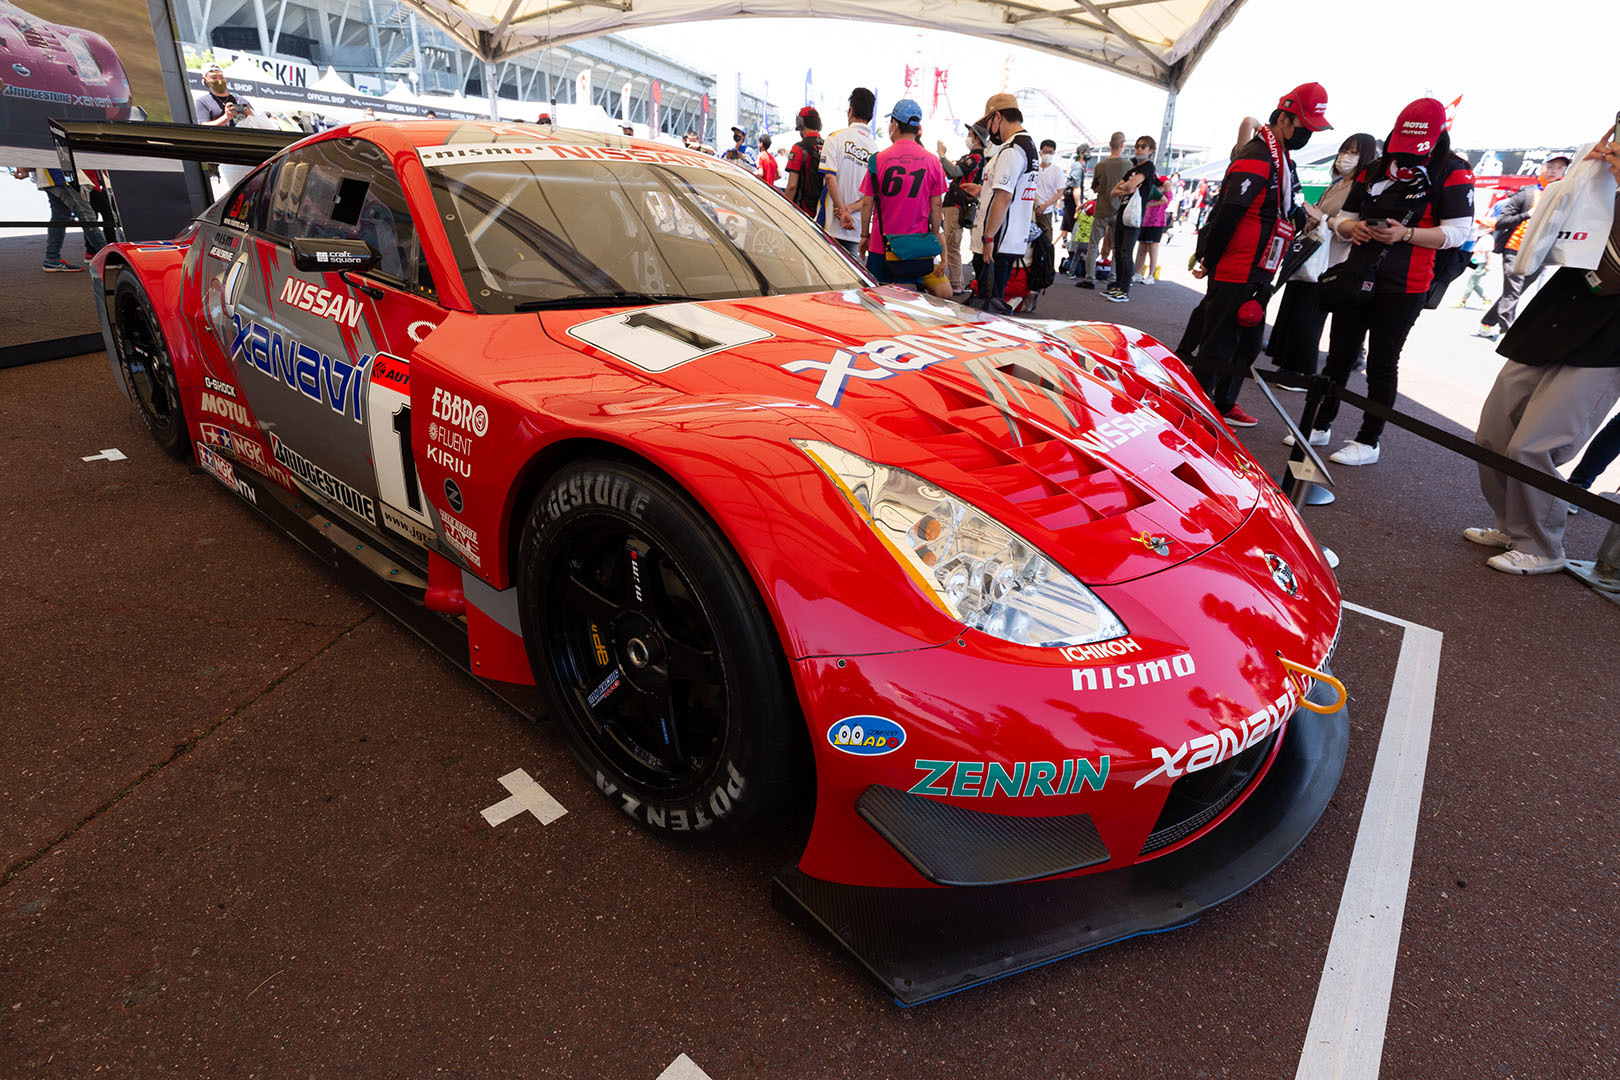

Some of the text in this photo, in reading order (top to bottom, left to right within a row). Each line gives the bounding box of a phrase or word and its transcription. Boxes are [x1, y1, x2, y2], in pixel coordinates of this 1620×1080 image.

[3, 84, 72, 104] BRIDGESTONE
[234, 82, 253, 92] SHOP
[307, 92, 331, 103] OFFICIAL
[331, 95, 345, 104] SHOP
[436, 146, 533, 160] nismo
[548, 145, 709, 169] NISSAN
[1417, 141, 1430, 152] 23
[881, 165, 926, 198] 61
[214, 232, 240, 249] nismo
[280, 277, 364, 328] NISSAN
[619, 312, 728, 352] 1
[204, 376, 237, 398] G-SHOCK
[201, 392, 251, 428] MOTUL
[432, 387, 489, 437] EBBRO
[438, 426, 473, 456] FLUENT
[1070, 406, 1168, 453] NISSAN
[233, 436, 264, 466] NGK
[392, 402, 425, 517] 1
[427, 444, 471, 478] KIRIU
[213, 455, 235, 483] NGK
[266, 464, 292, 491] NTN
[269, 431, 377, 526] BRIDGESTONE
[234, 477, 257, 505] NTN
[1059, 637, 1143, 662] ICHIKOH
[1071, 653, 1196, 691] nismo
[907, 755, 1110, 797] ZENRIN
[596, 760, 746, 831] POTENZA
